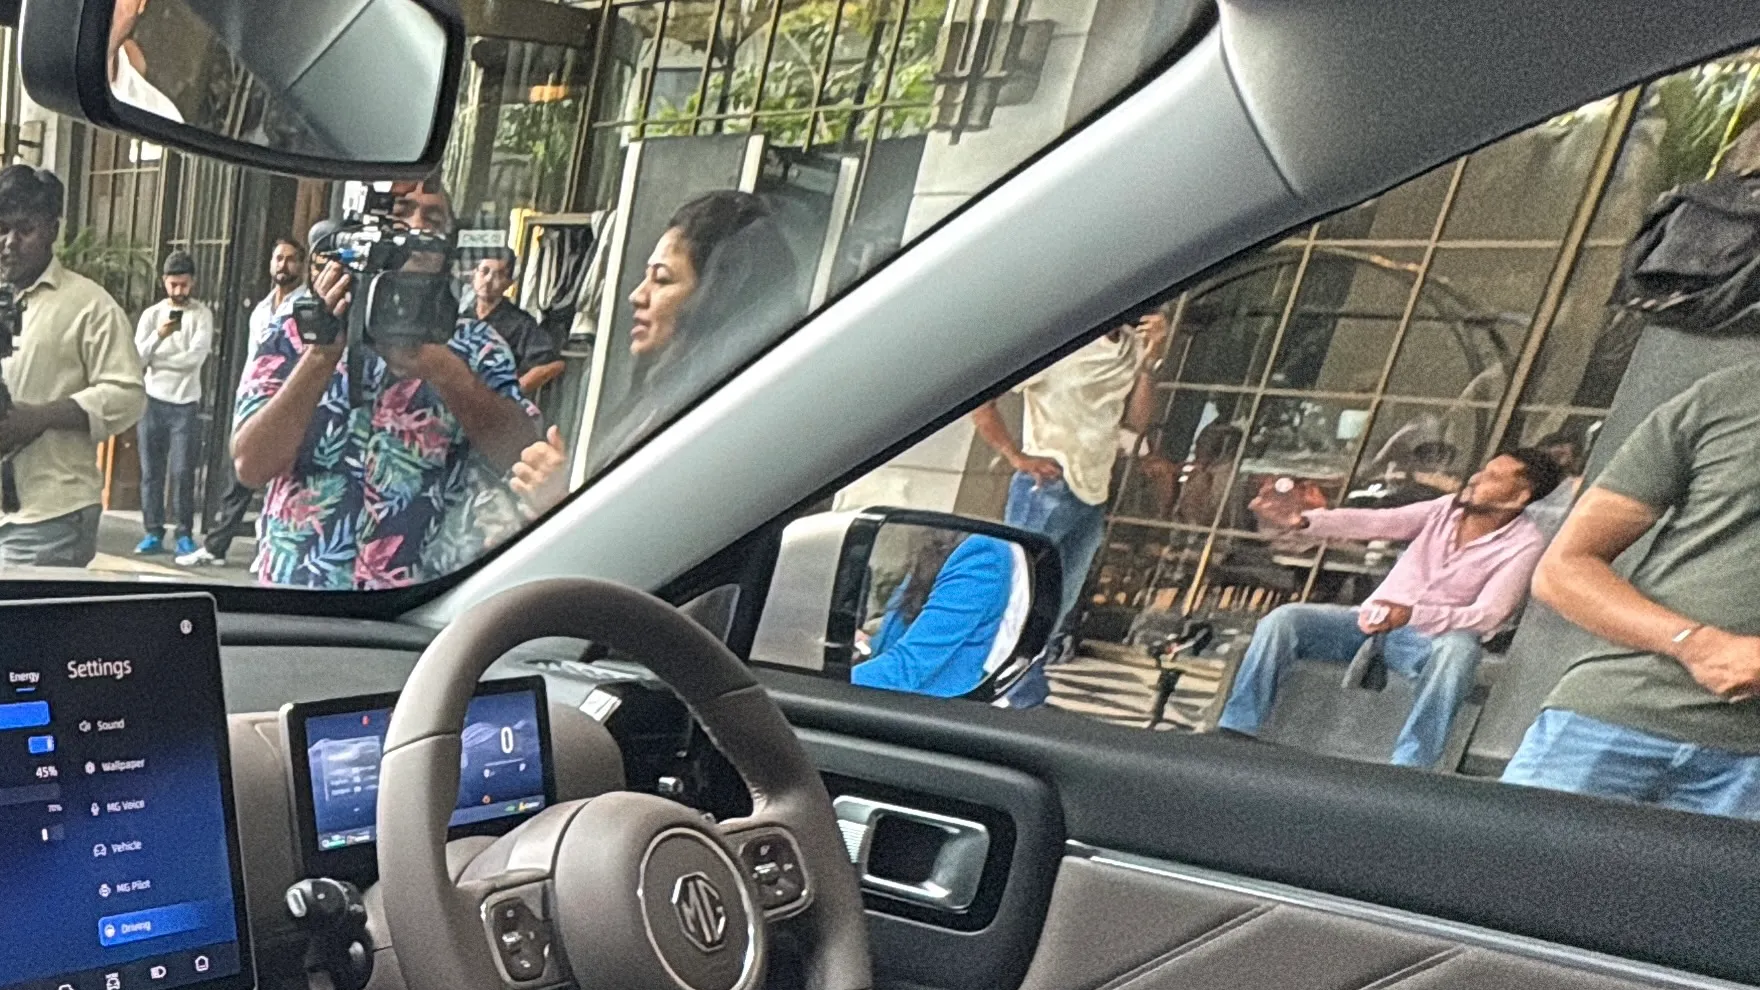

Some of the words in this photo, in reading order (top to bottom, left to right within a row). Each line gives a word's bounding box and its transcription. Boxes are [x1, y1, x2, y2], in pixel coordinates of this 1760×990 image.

[67, 657, 132, 680] Settings
[9, 671, 40, 683] Energy
[97, 718, 125, 731] Sound
[500, 726, 514, 754] 0
[36, 765, 58, 779] 45%
[101, 758, 145, 772] Wallpaper
[106, 802, 121, 813] MG
[111, 841, 142, 853] Vehicle
[116, 883, 131, 893] MG
[131, 880, 151, 891] Pilot
[678, 876, 726, 946] MG
[121, 921, 151, 935] Driving
